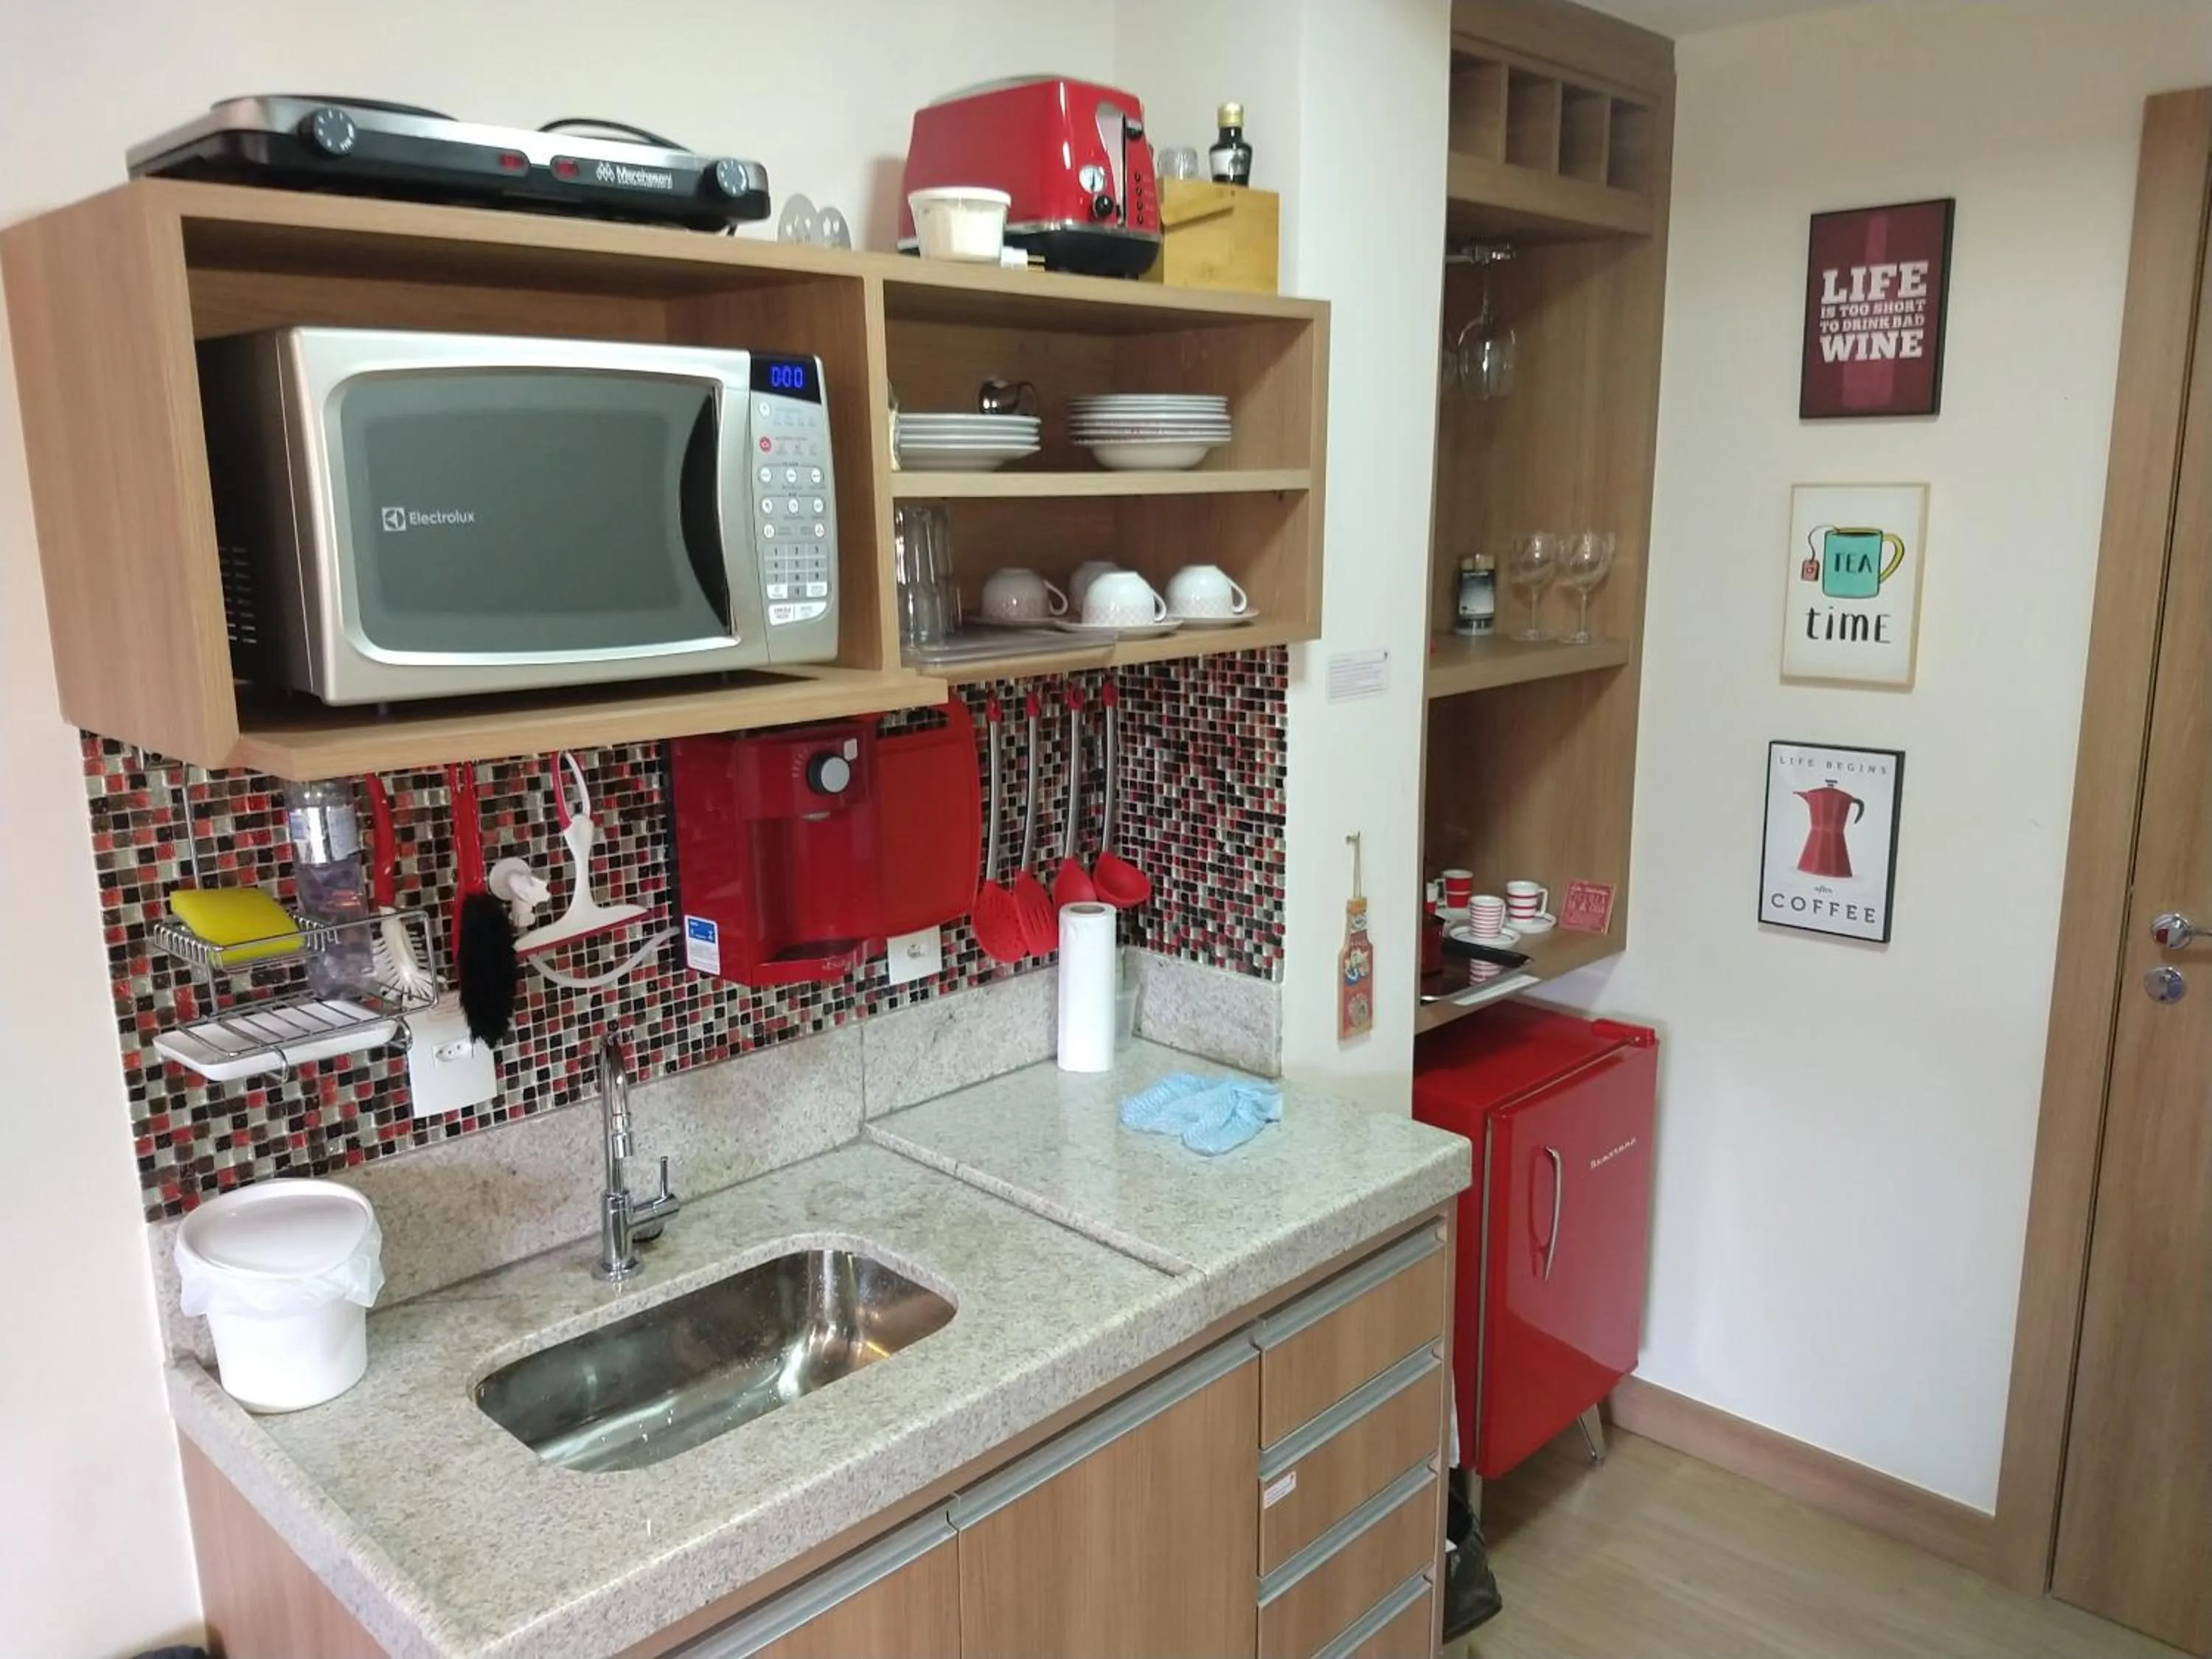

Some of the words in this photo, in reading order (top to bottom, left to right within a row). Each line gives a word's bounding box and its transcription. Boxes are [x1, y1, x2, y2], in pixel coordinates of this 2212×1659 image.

[1821, 260, 1929, 304] LIFE
[1820, 305, 1836, 319] IS
[1840, 302, 1870, 318] TOO
[1873, 298, 1926, 315] SHORT
[1820, 319, 1840, 333] TO
[1842, 316, 1890, 332] DRINK
[1892, 312, 1925, 328] BAD
[1820, 329, 1924, 363] WINE
[408, 509, 475, 525] Electrolux
[1834, 552, 1872, 574] TEA
[1779, 755, 1814, 768] LIFE
[1826, 760, 1887, 774] BEGINS
[1770, 893, 1876, 924] COFFEE
